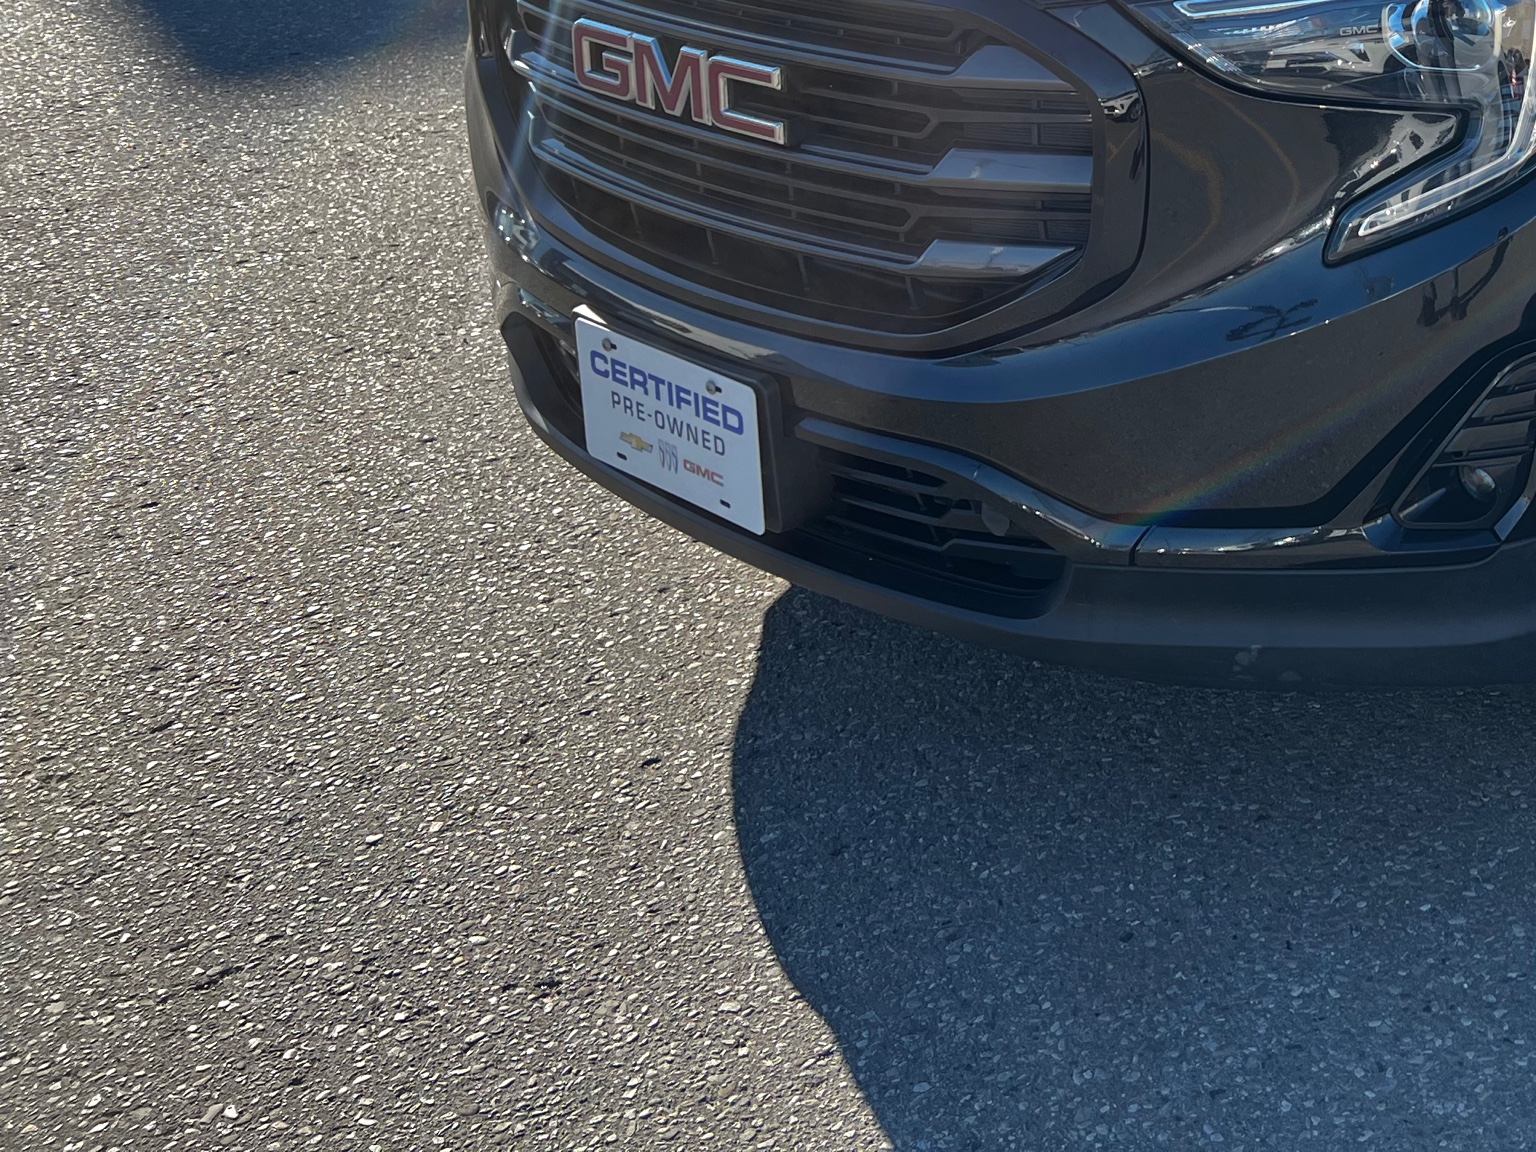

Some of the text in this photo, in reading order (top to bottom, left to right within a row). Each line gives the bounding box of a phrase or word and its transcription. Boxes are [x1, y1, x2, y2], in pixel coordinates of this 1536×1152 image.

[1340, 24, 1378, 36] GMC
[571, 17, 785, 145] GMC
[590, 350, 744, 436] CERTIFIED
[611, 390, 726, 456] PRE-OWNED
[683, 459, 724, 487] GMC
